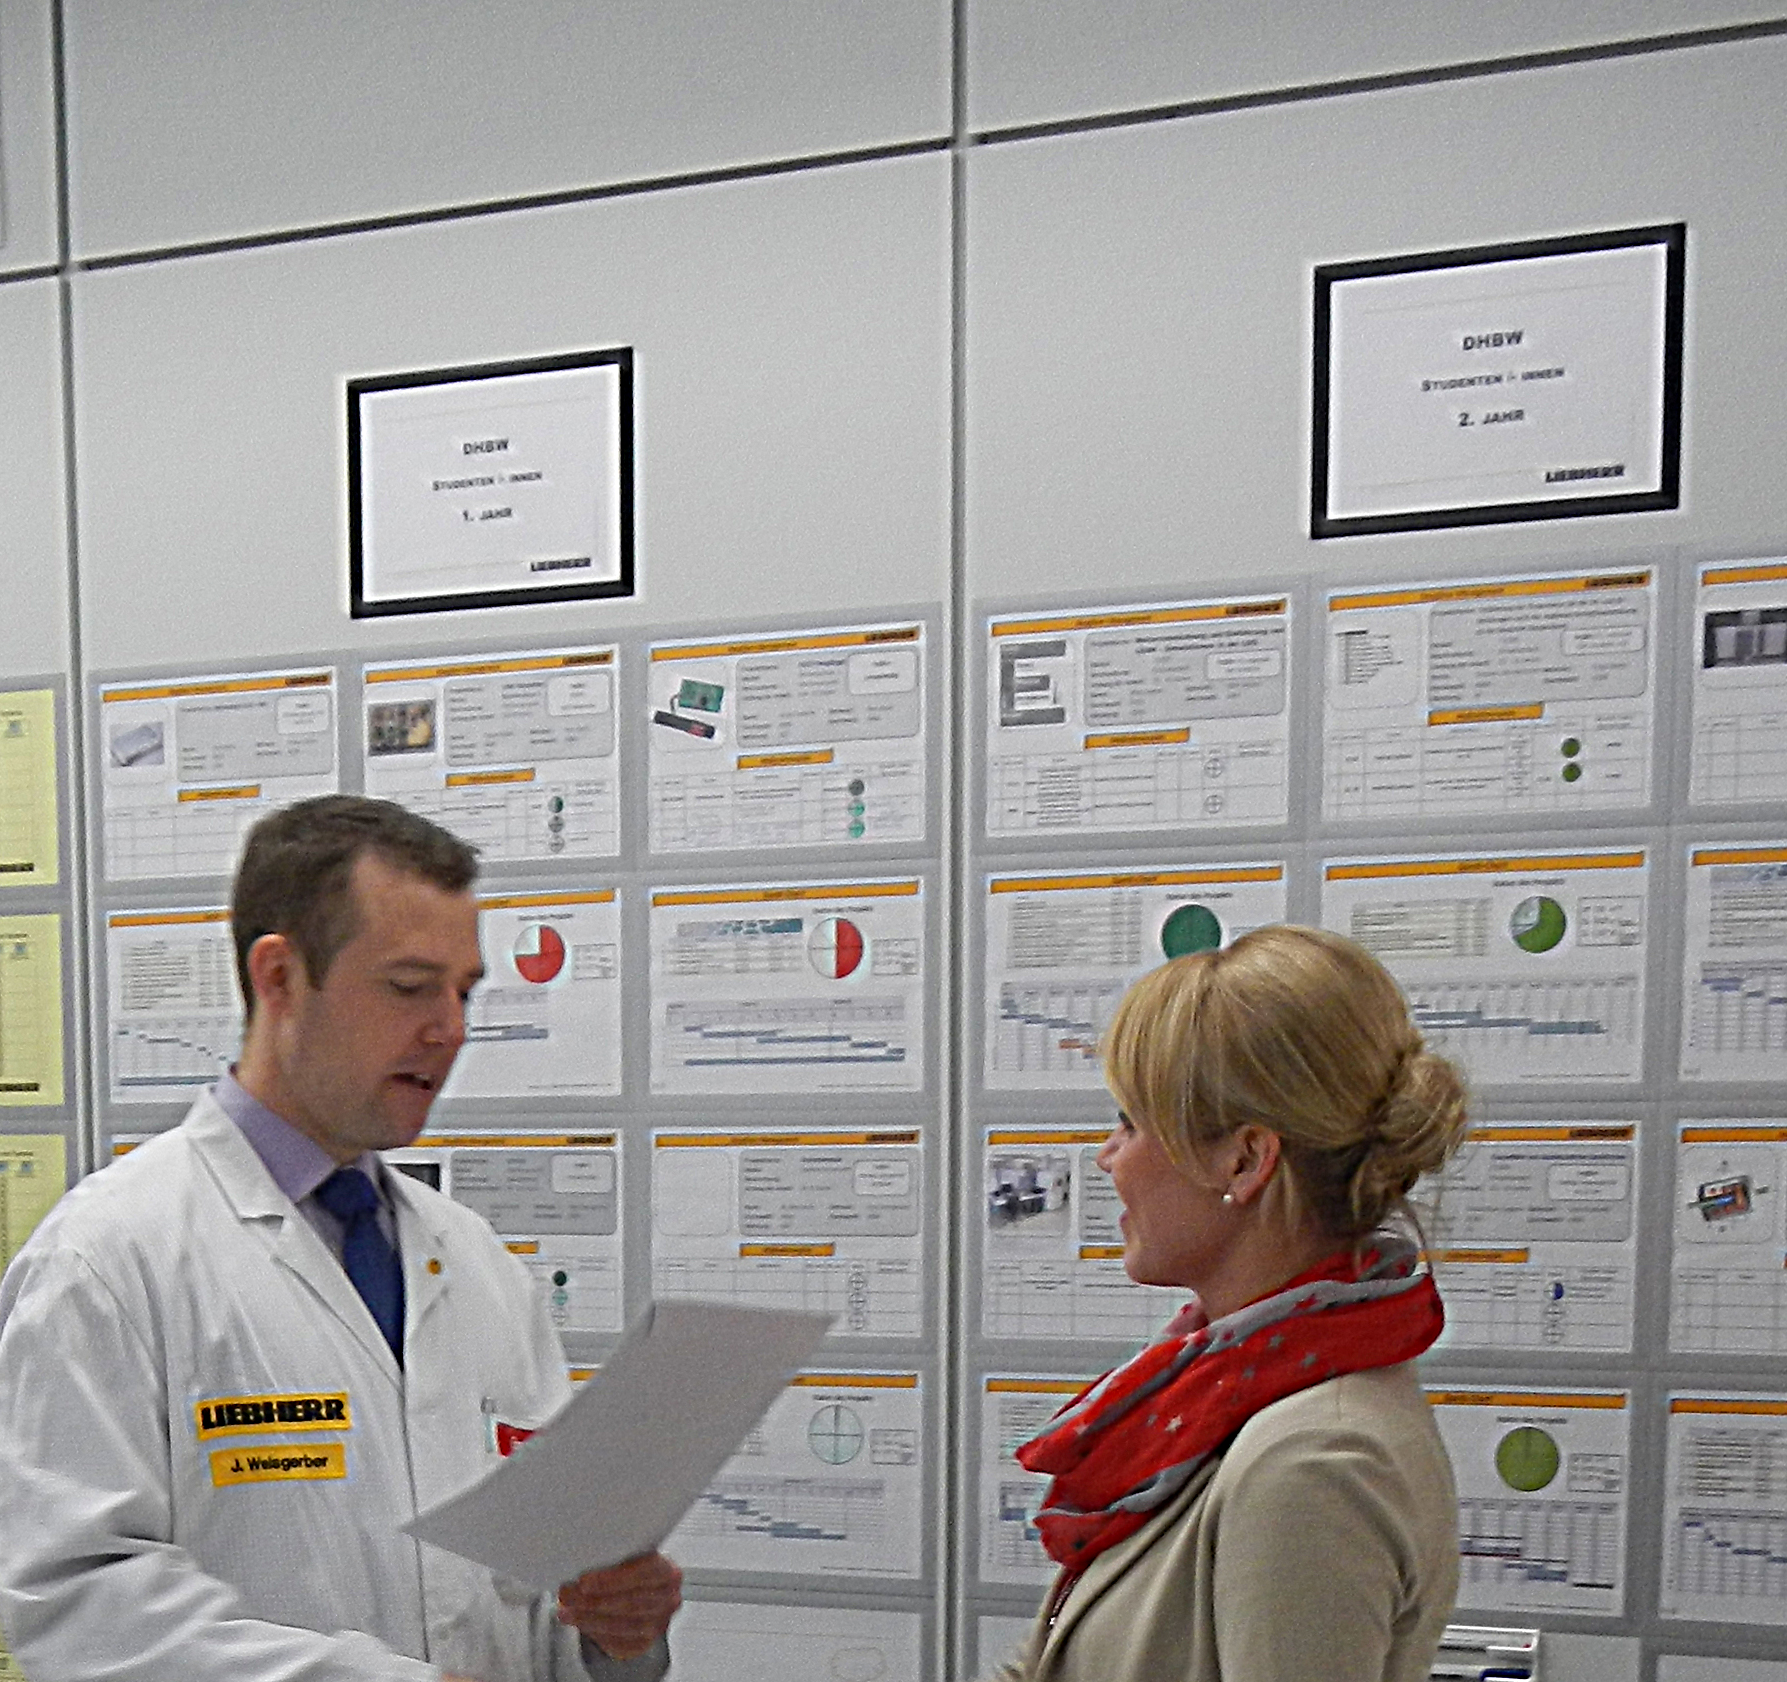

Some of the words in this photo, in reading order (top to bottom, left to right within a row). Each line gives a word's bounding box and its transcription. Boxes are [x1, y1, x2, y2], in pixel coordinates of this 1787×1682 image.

[1463, 330, 1524, 351] DHBW
[1458, 412, 1475, 427] 2.
[1482, 408, 1525, 425] JAHR
[463, 438, 509, 455] DHBW
[201, 1398, 346, 1430] LIEBHERR
[231, 1458, 244, 1473] J.
